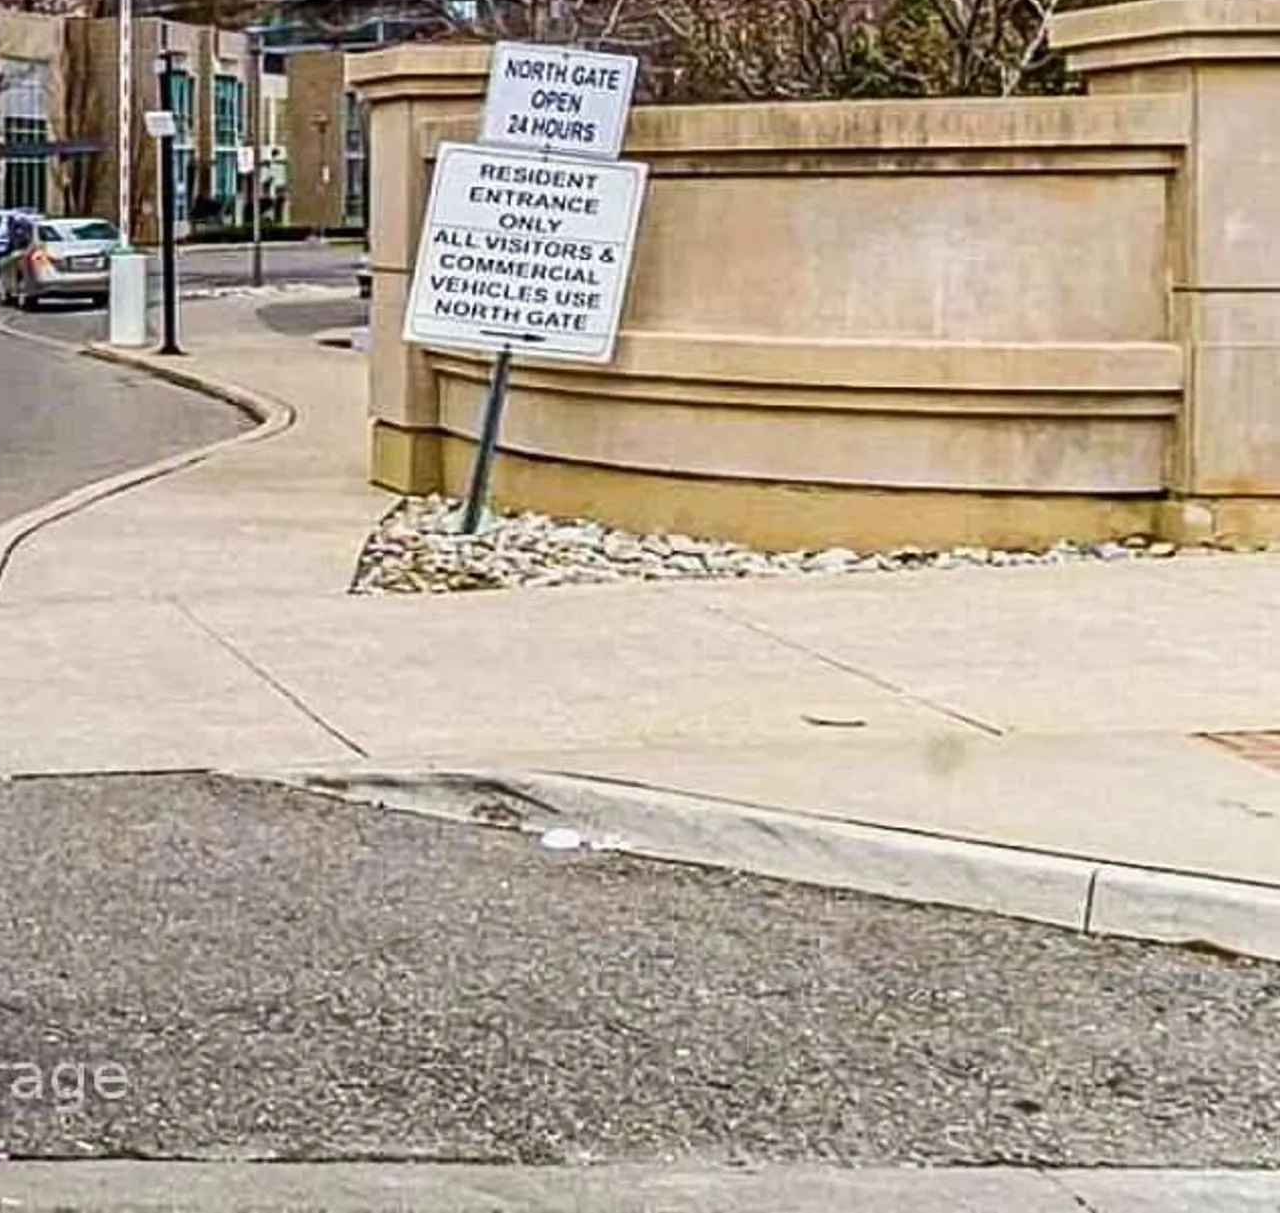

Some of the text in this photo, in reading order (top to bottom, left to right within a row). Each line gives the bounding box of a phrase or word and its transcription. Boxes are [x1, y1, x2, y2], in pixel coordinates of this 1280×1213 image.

[504, 58, 620, 90] NORTH GATE
[530, 89, 582, 113] OPEN
[507, 113, 595, 142] 24 HOURS
[480, 163, 598, 189] RESIDENT
[469, 186, 600, 215] ENTRANCE
[498, 213, 562, 234] ONLY
[433, 229, 616, 263] ALL VISITORS &
[439, 253, 601, 285] COMMERCIAL
[430, 274, 602, 309] VEHICLES USE
[434, 298, 588, 331] NORTH GATE
